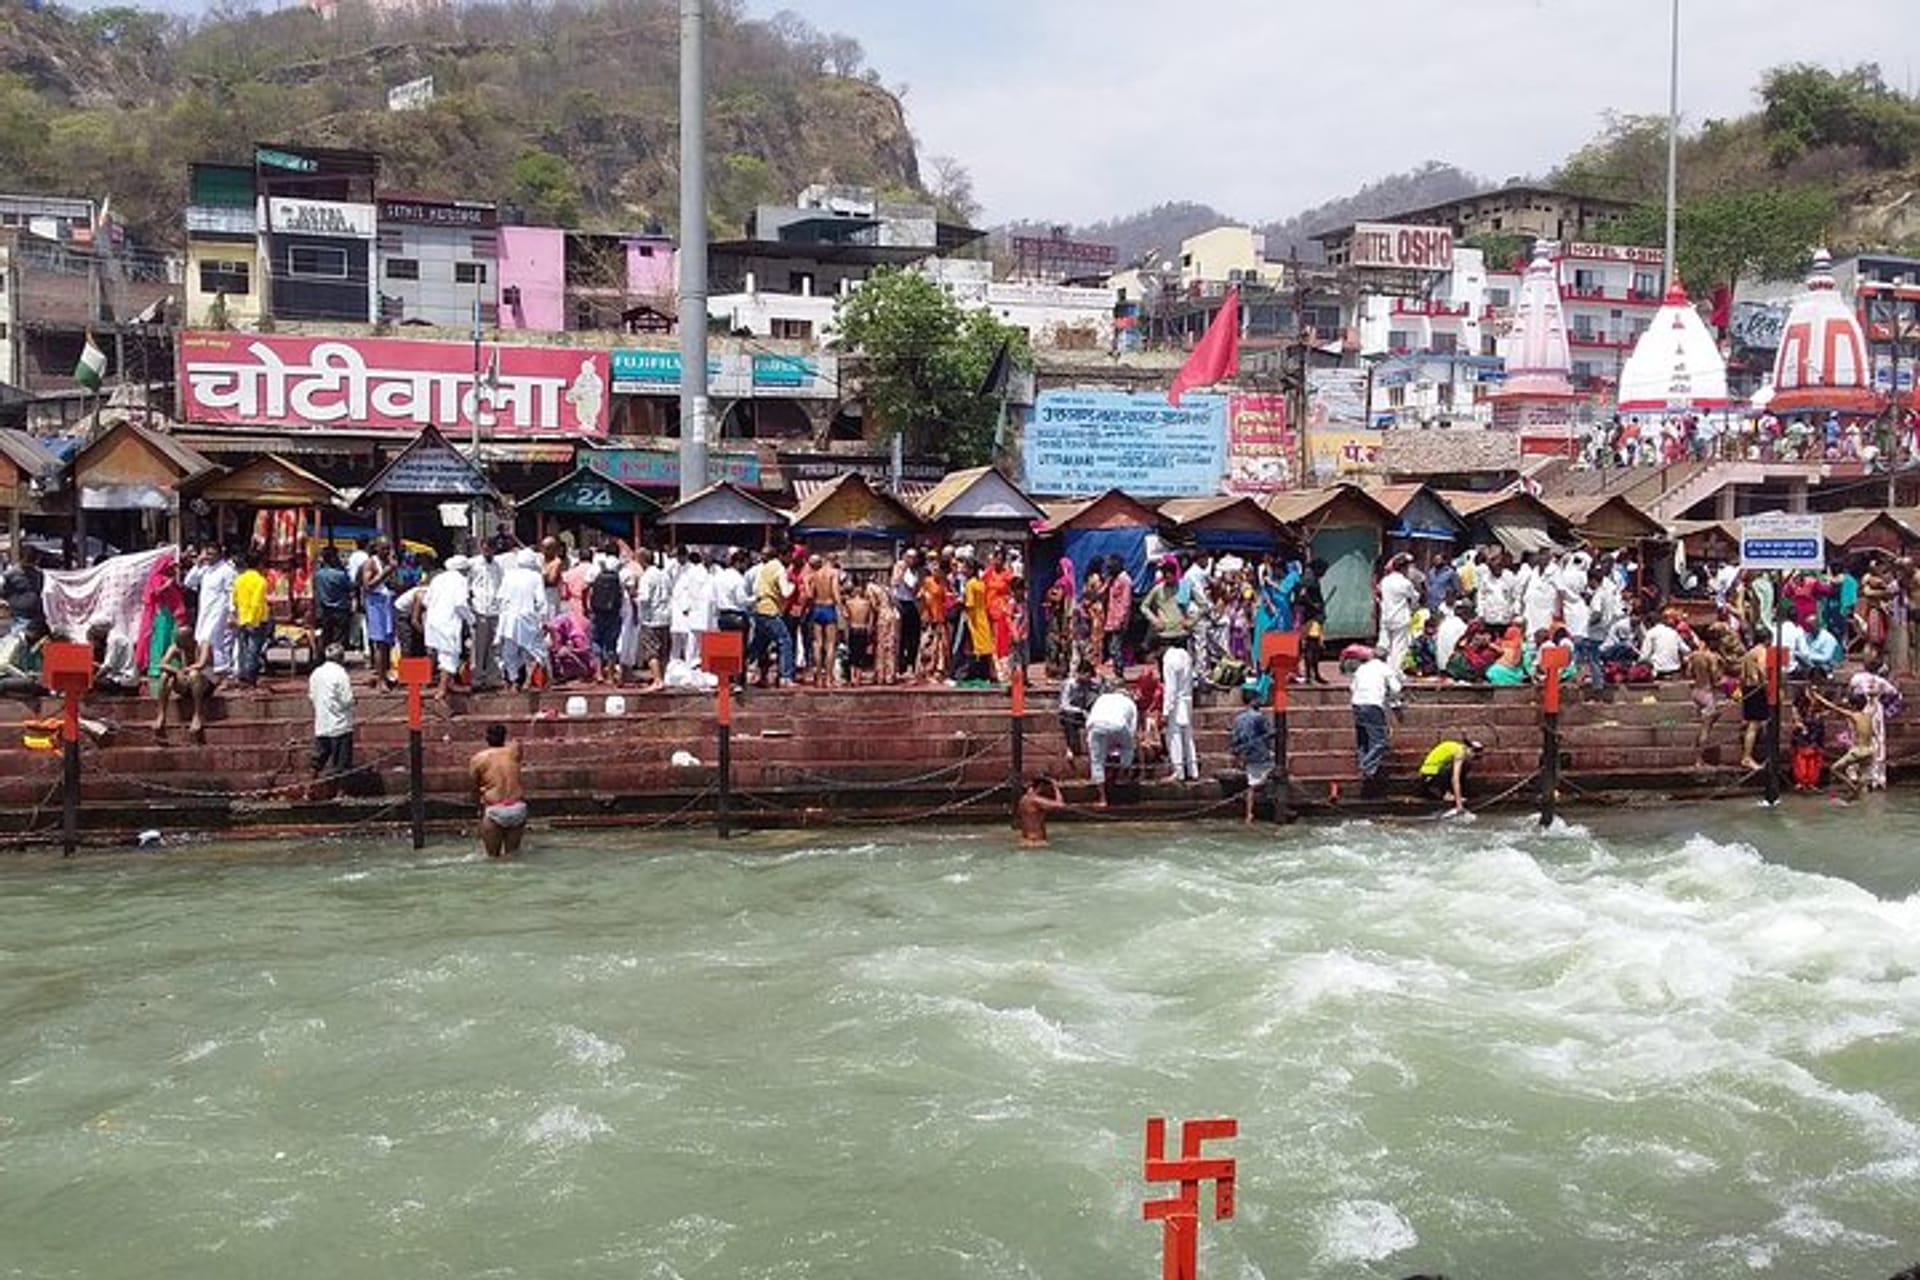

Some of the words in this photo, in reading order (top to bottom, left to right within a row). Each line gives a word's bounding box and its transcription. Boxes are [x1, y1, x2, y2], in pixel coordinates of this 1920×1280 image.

[1398, 229, 1450, 267] OSHO
[1573, 245, 1620, 257] HOTEL
[186, 342, 567, 428] चोटीवाला
[576, 487, 613, 506] 24
